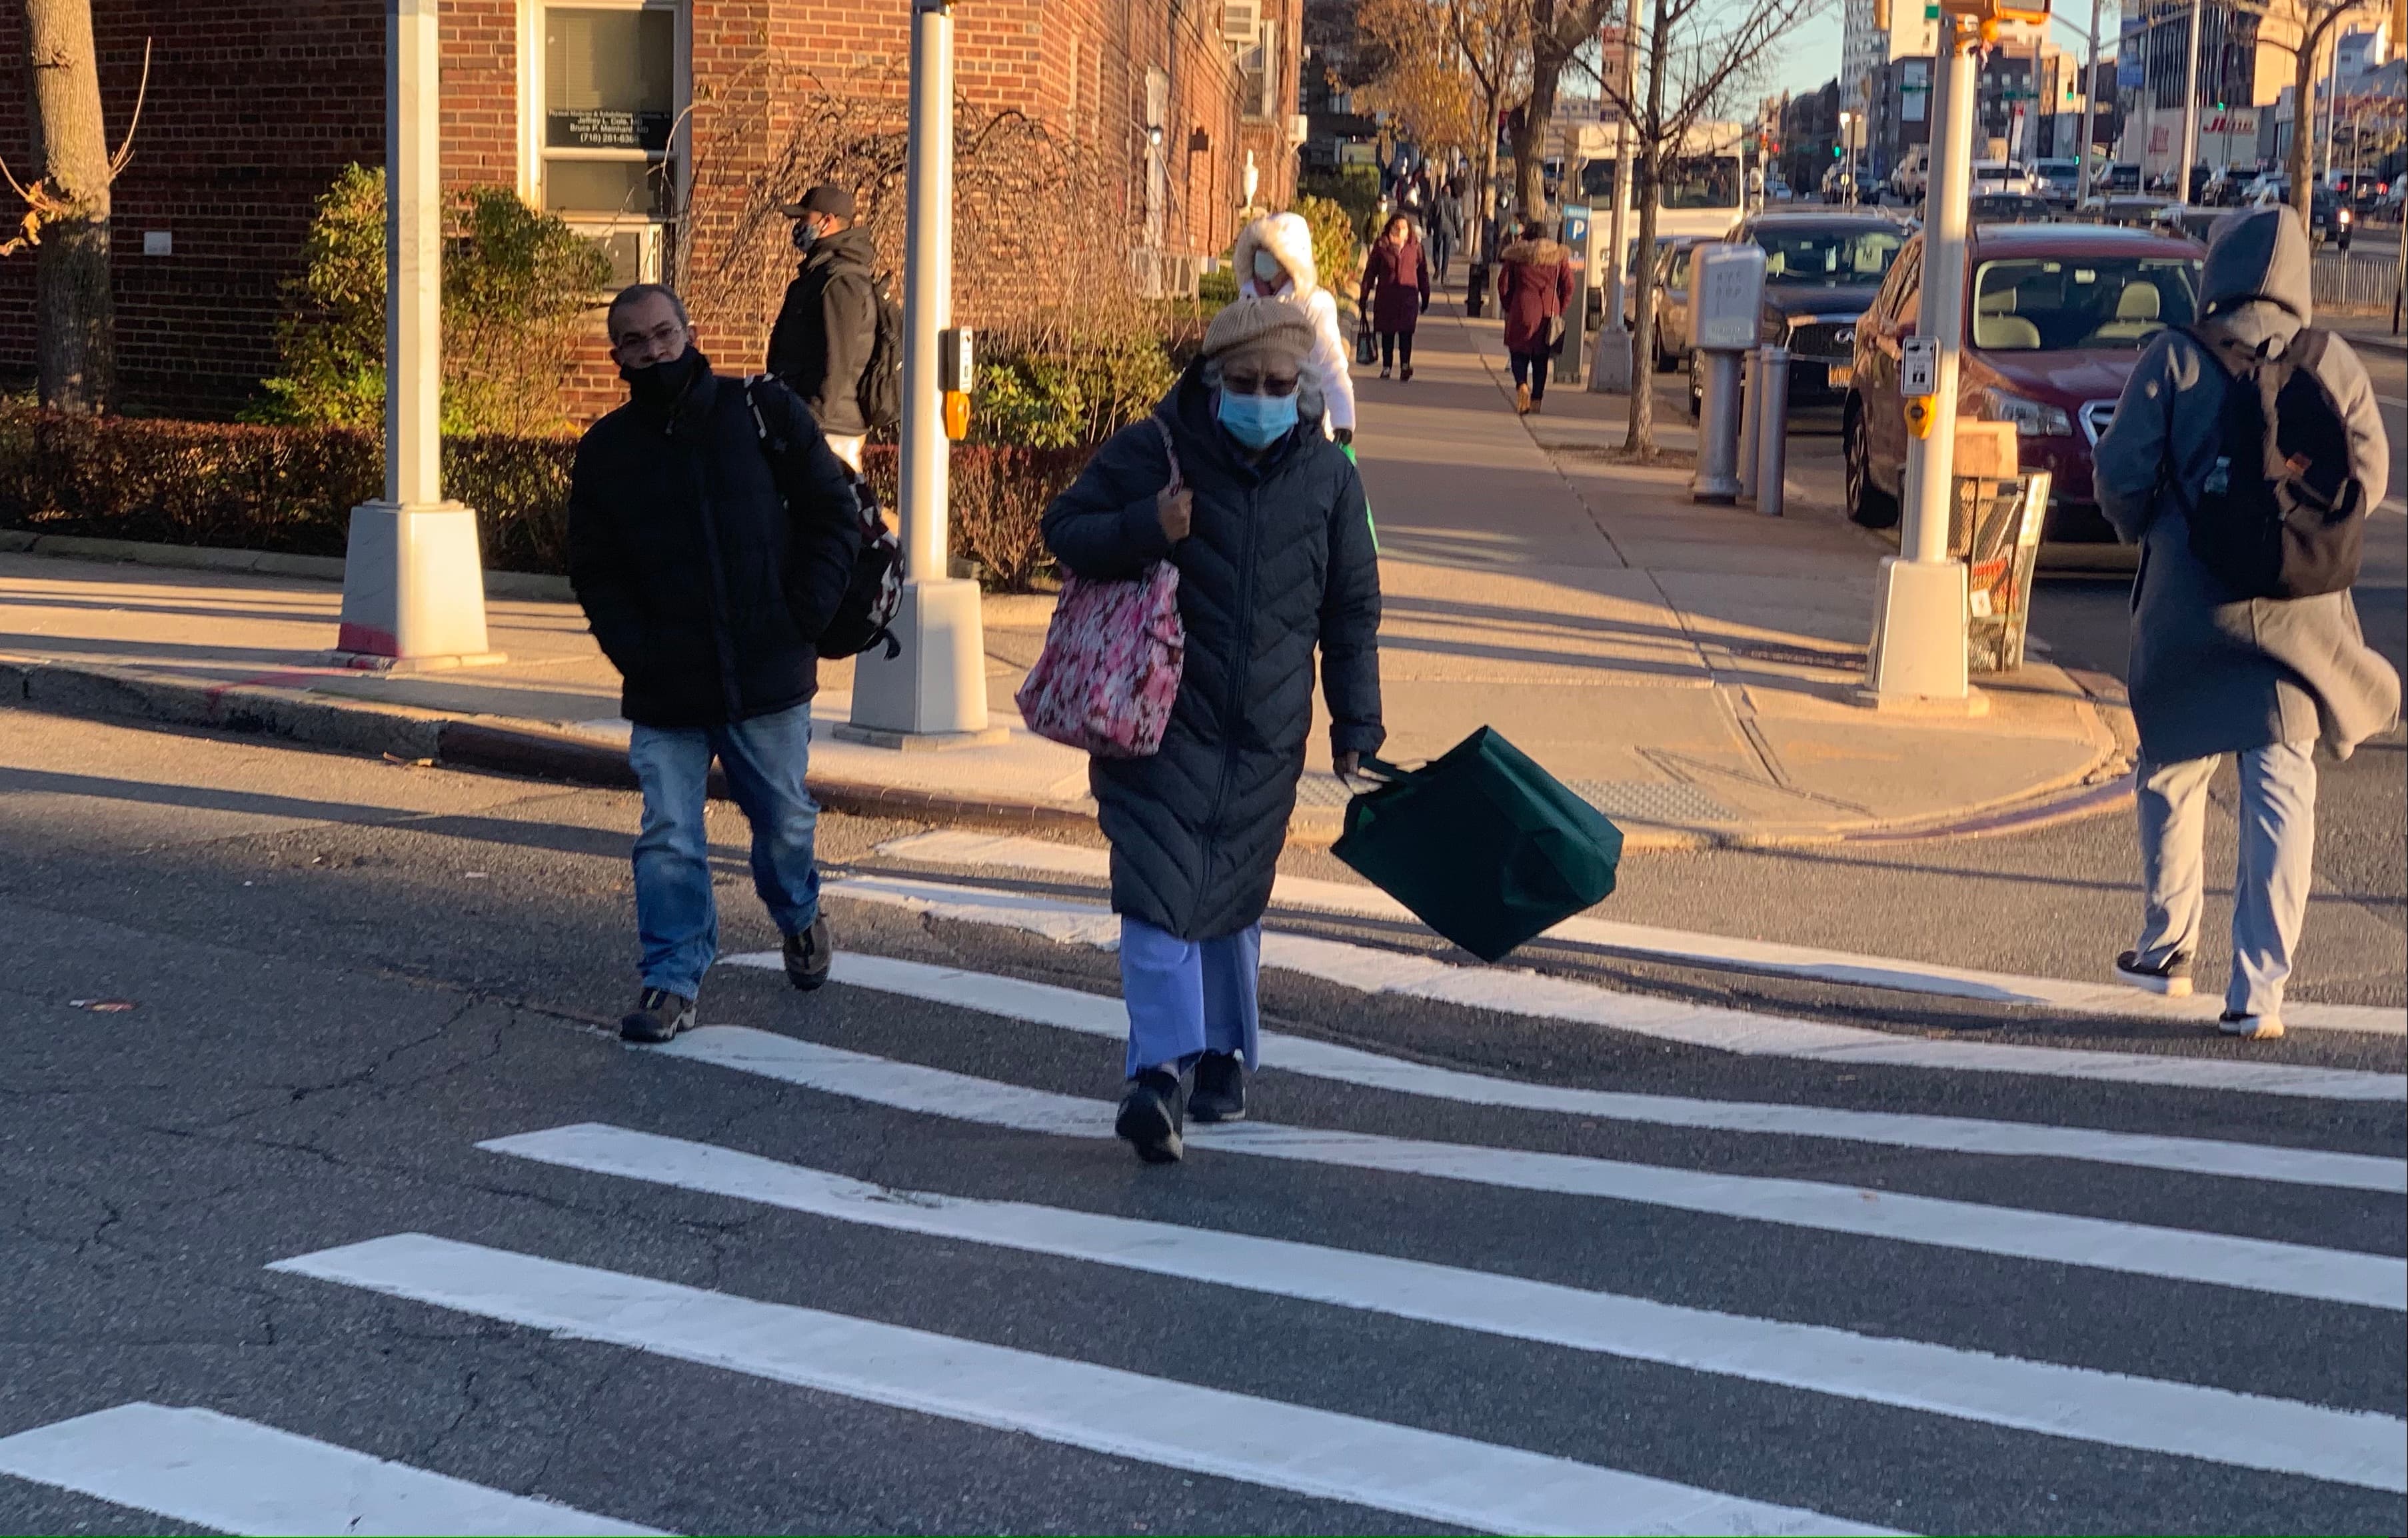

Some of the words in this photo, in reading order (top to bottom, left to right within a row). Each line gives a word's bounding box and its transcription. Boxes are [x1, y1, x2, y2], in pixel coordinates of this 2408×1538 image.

[570, 123, 591, 132] Bruce
[580, 133, 601, 143] (718)
[1572, 219, 1585, 240] P
